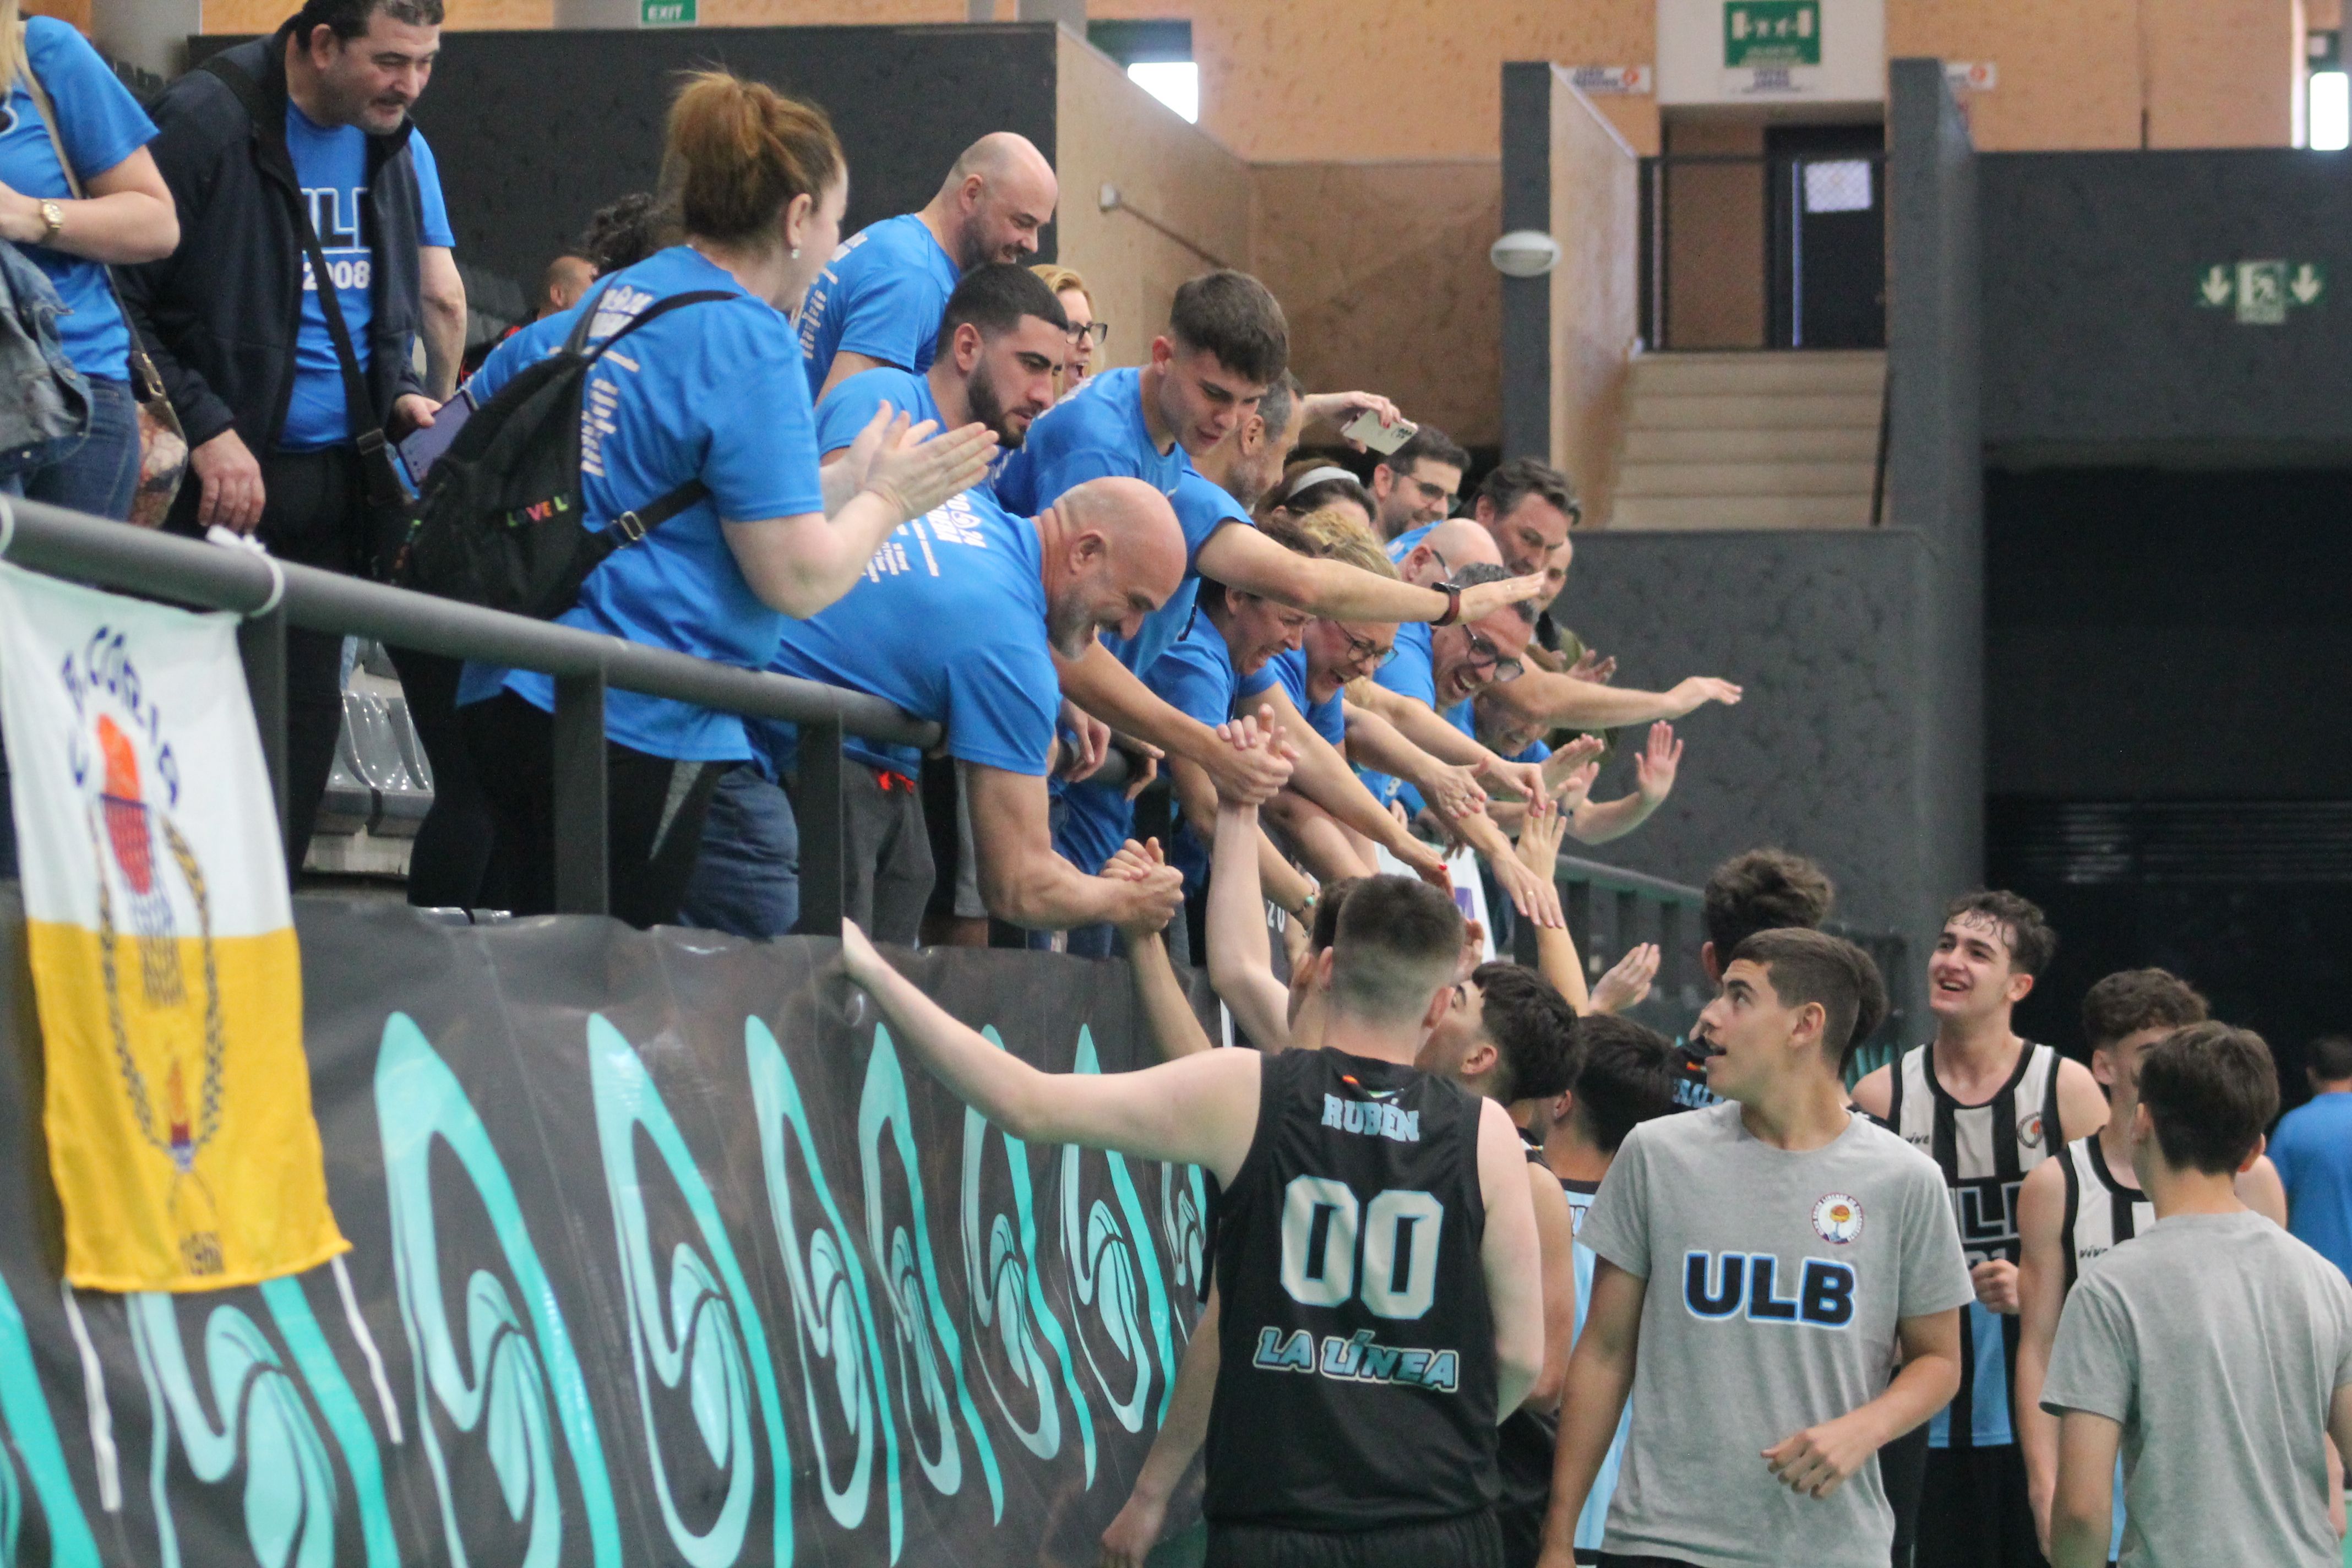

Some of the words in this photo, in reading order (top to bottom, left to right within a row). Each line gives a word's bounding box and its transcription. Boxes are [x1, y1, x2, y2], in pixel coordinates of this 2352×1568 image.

[648, 4, 682, 20] EXIT
[1322, 1093, 1419, 1142] RUBÉN
[1280, 1174, 1444, 1320] 00
[1683, 1250, 1856, 1330] ULB
[1253, 1326, 1315, 1373] LA
[1320, 1329, 1460, 1392] LÍNEA
